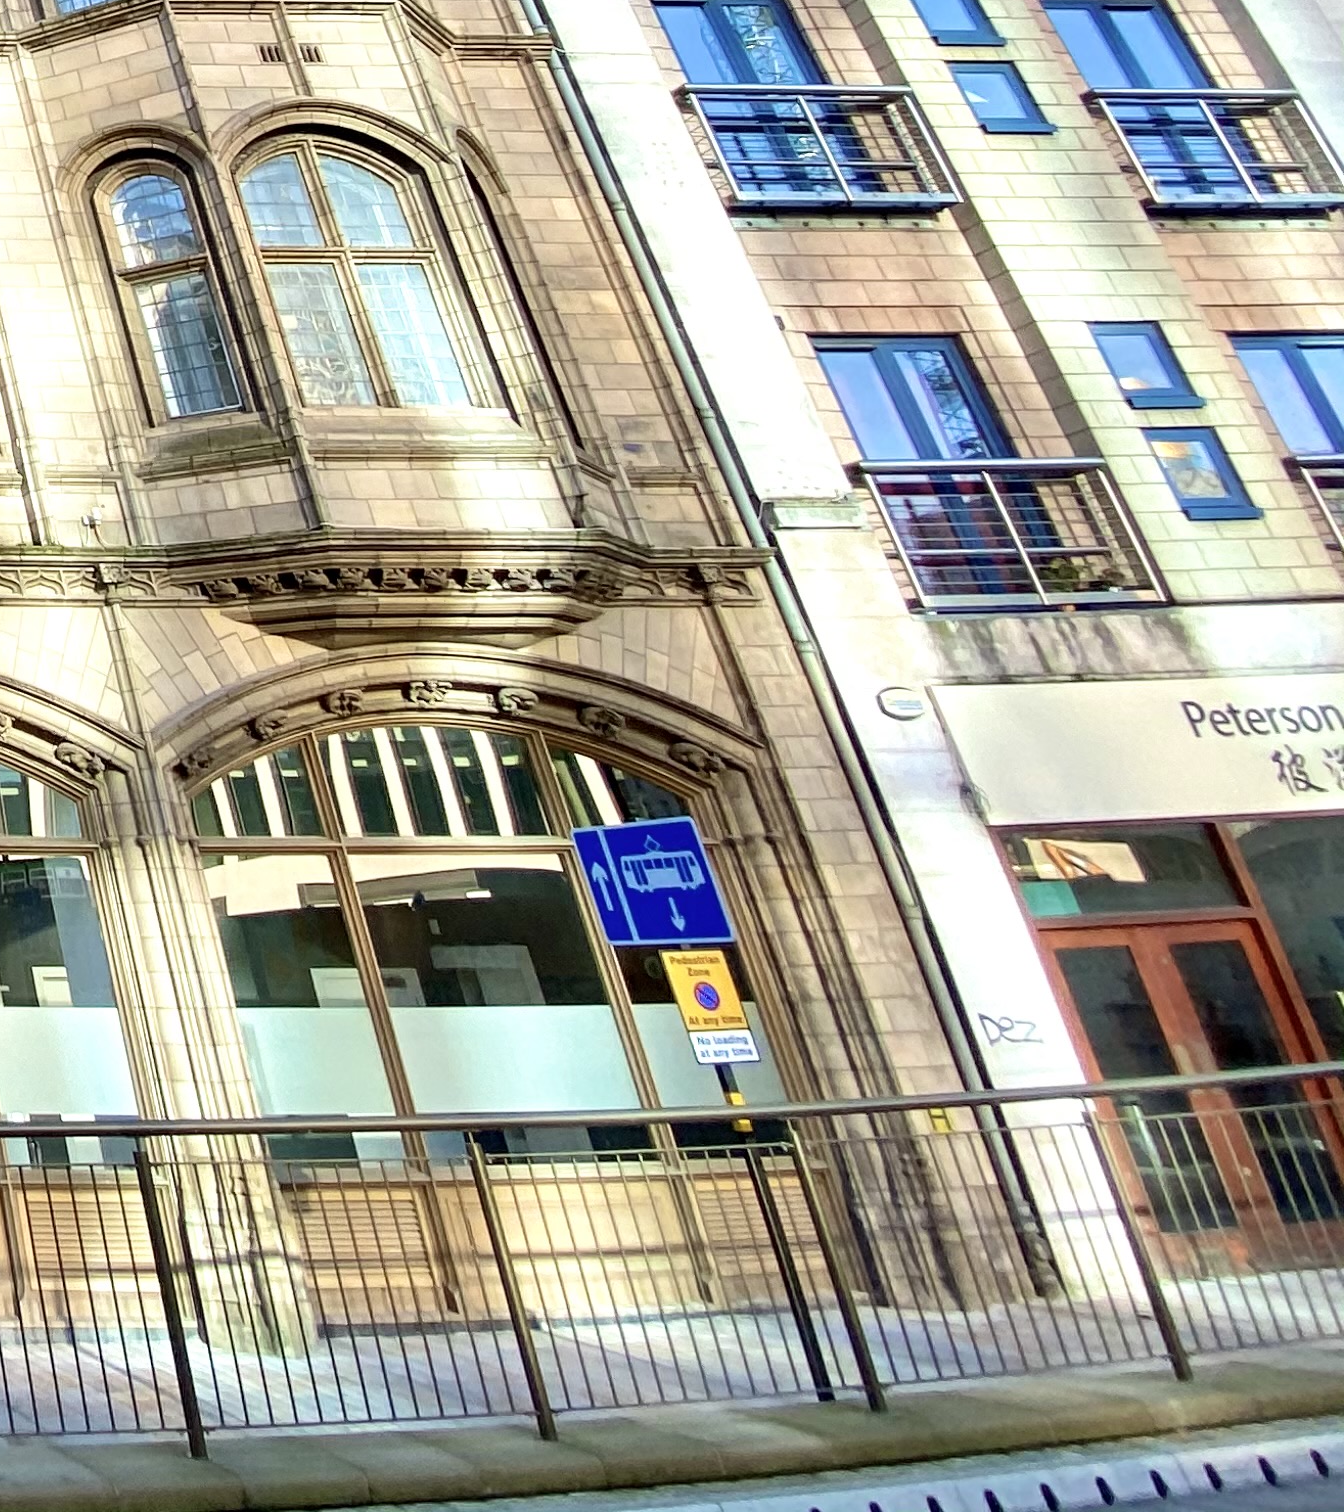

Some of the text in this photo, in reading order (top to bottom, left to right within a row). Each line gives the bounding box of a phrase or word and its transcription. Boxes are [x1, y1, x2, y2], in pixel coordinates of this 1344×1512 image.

[1180, 698, 1344, 738] Peterson
[688, 1015, 743, 1027] At any time
[696, 1035, 748, 1046] No loading
[700, 1047, 753, 1059] at any time
